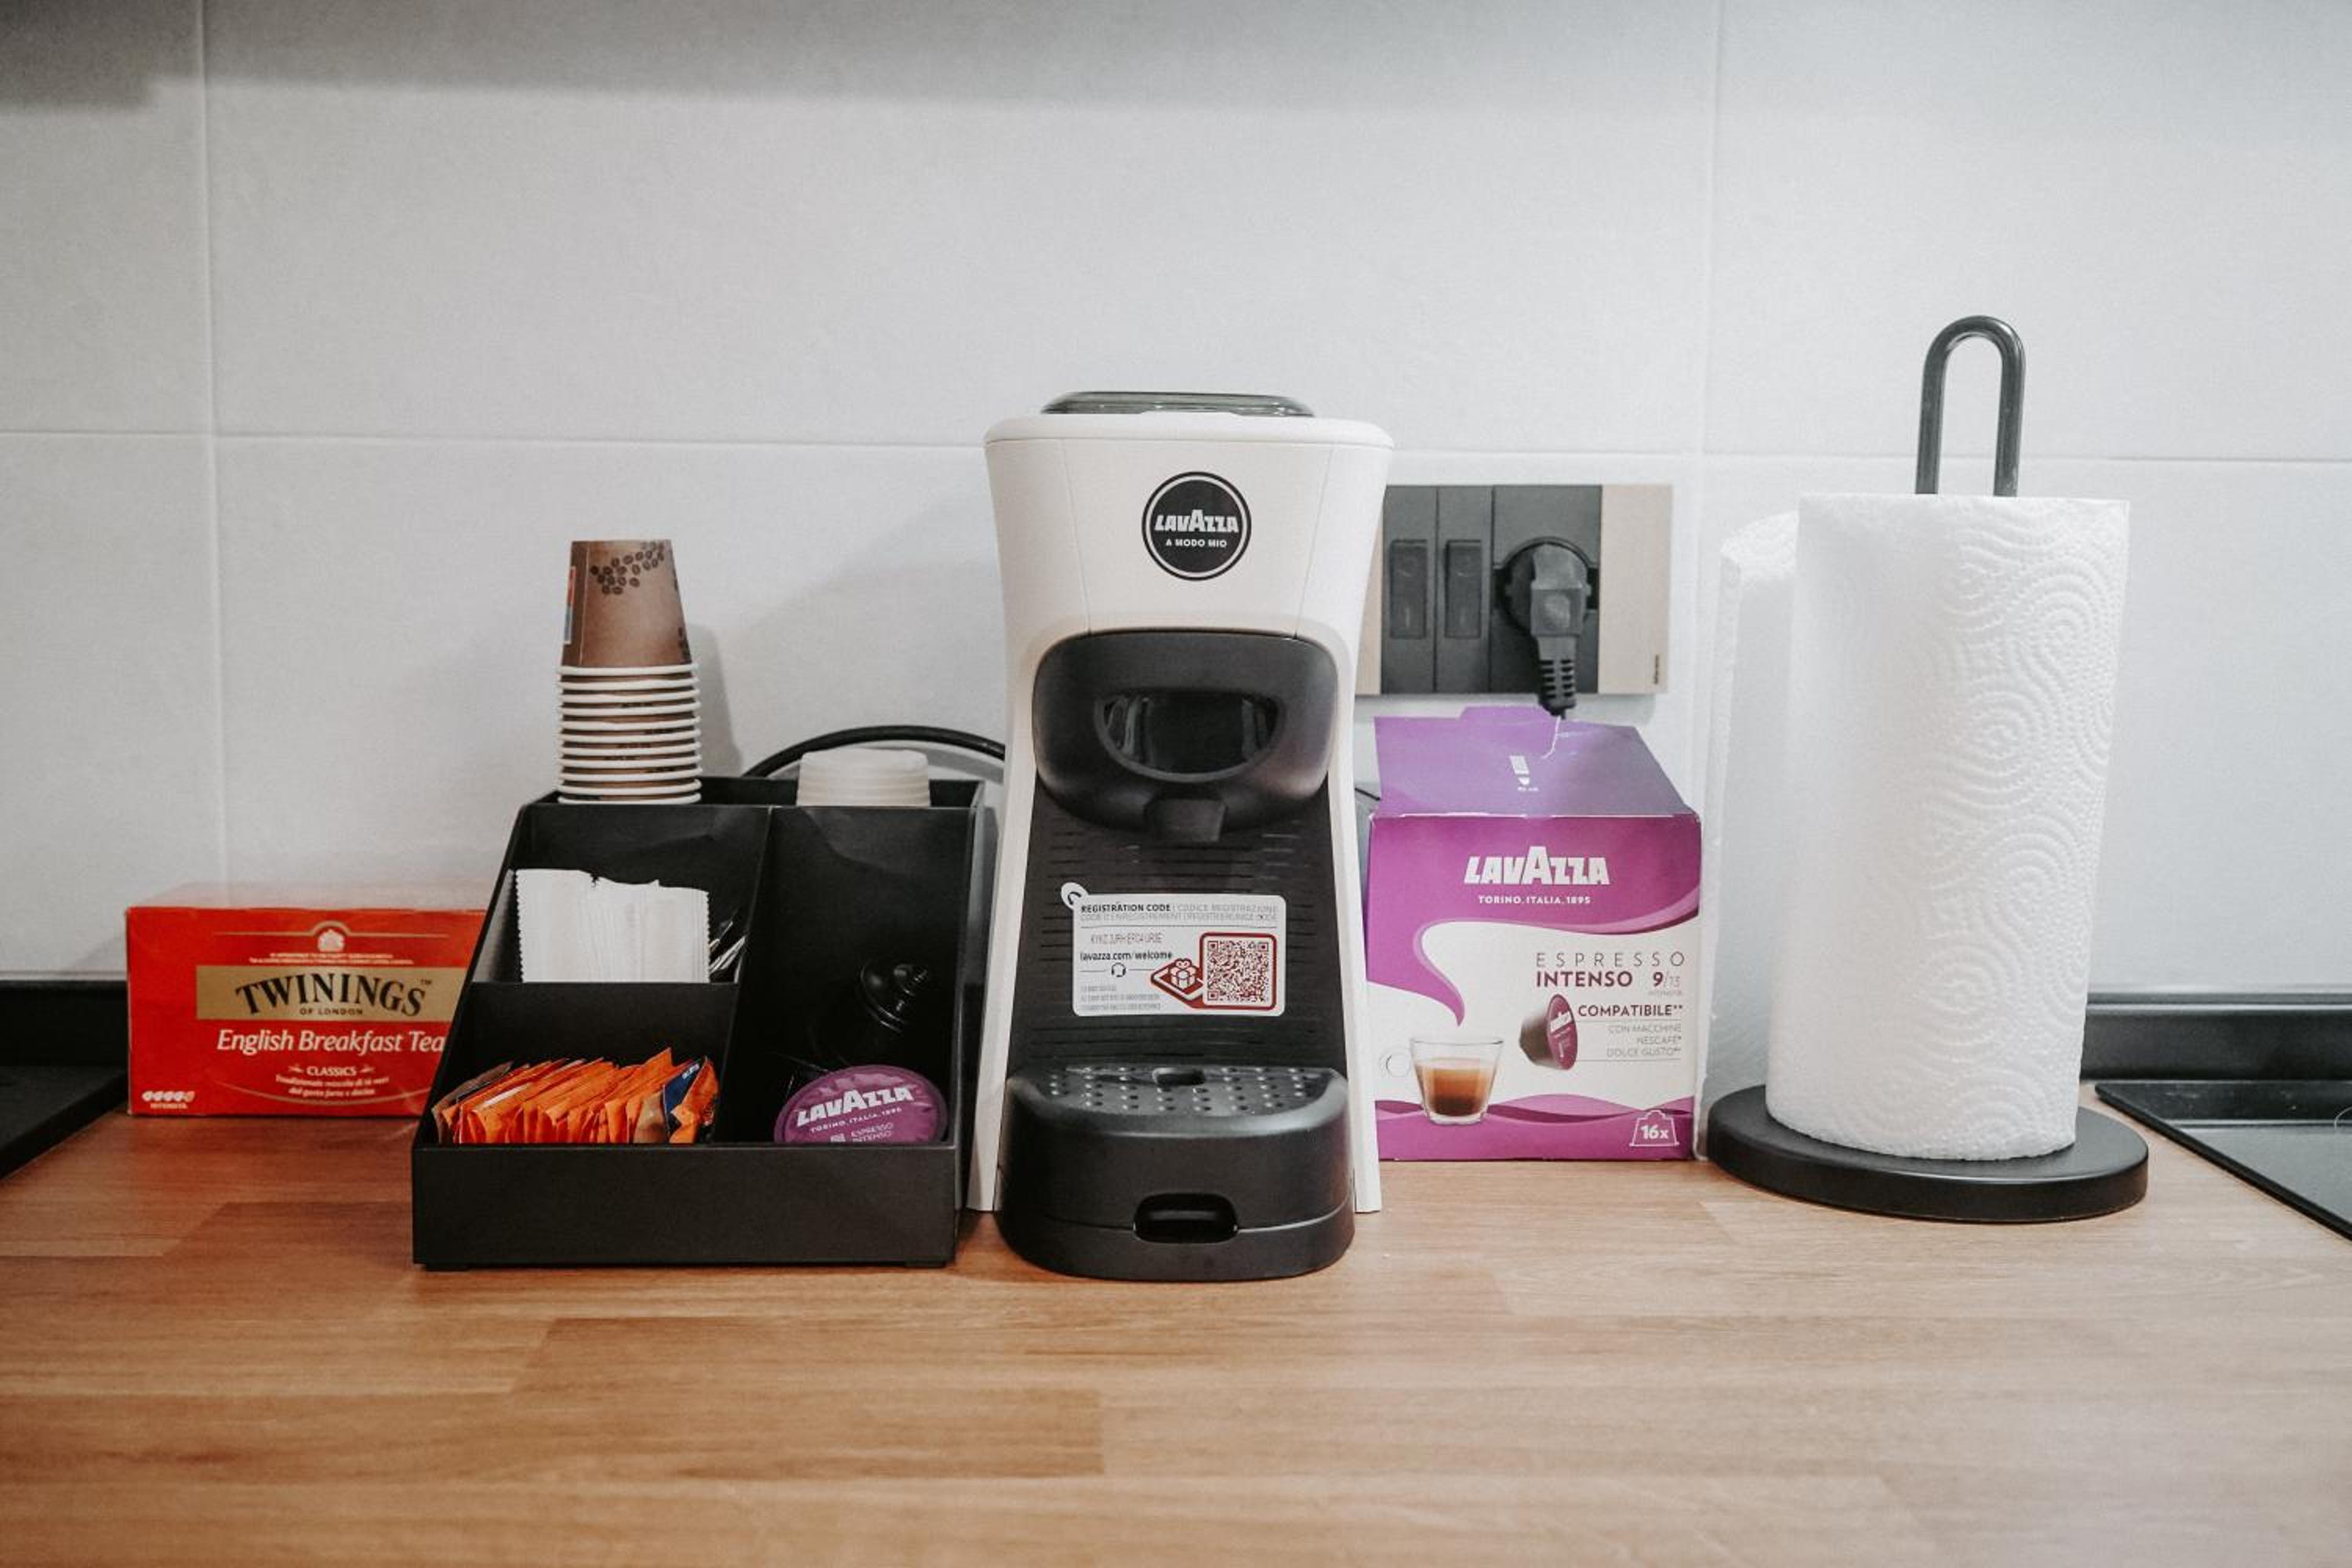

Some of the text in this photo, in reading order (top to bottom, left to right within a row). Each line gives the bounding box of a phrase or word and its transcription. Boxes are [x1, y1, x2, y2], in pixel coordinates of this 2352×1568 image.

[1154, 509, 1239, 532] LAVAZZA
[1175, 539, 1206, 547] MODO
[1208, 539, 1228, 548] MIO
[1464, 845, 1611, 885] LAVAZZA
[1080, 903, 1144, 913] REGISTRATION
[1145, 903, 1171, 912] CODE
[1536, 950, 1685, 968] ESPRESSO
[1536, 971, 1633, 987] INTENSO
[235, 972, 426, 1017] TWININGS
[318, 1007, 364, 1016] LONDON
[216, 1029, 445, 1057] English Breakfast Tea
[307, 1065, 358, 1076] CLASSICS
[796, 1086, 915, 1127] LAVAZZA
[1640, 1123, 1669, 1140] 16x
